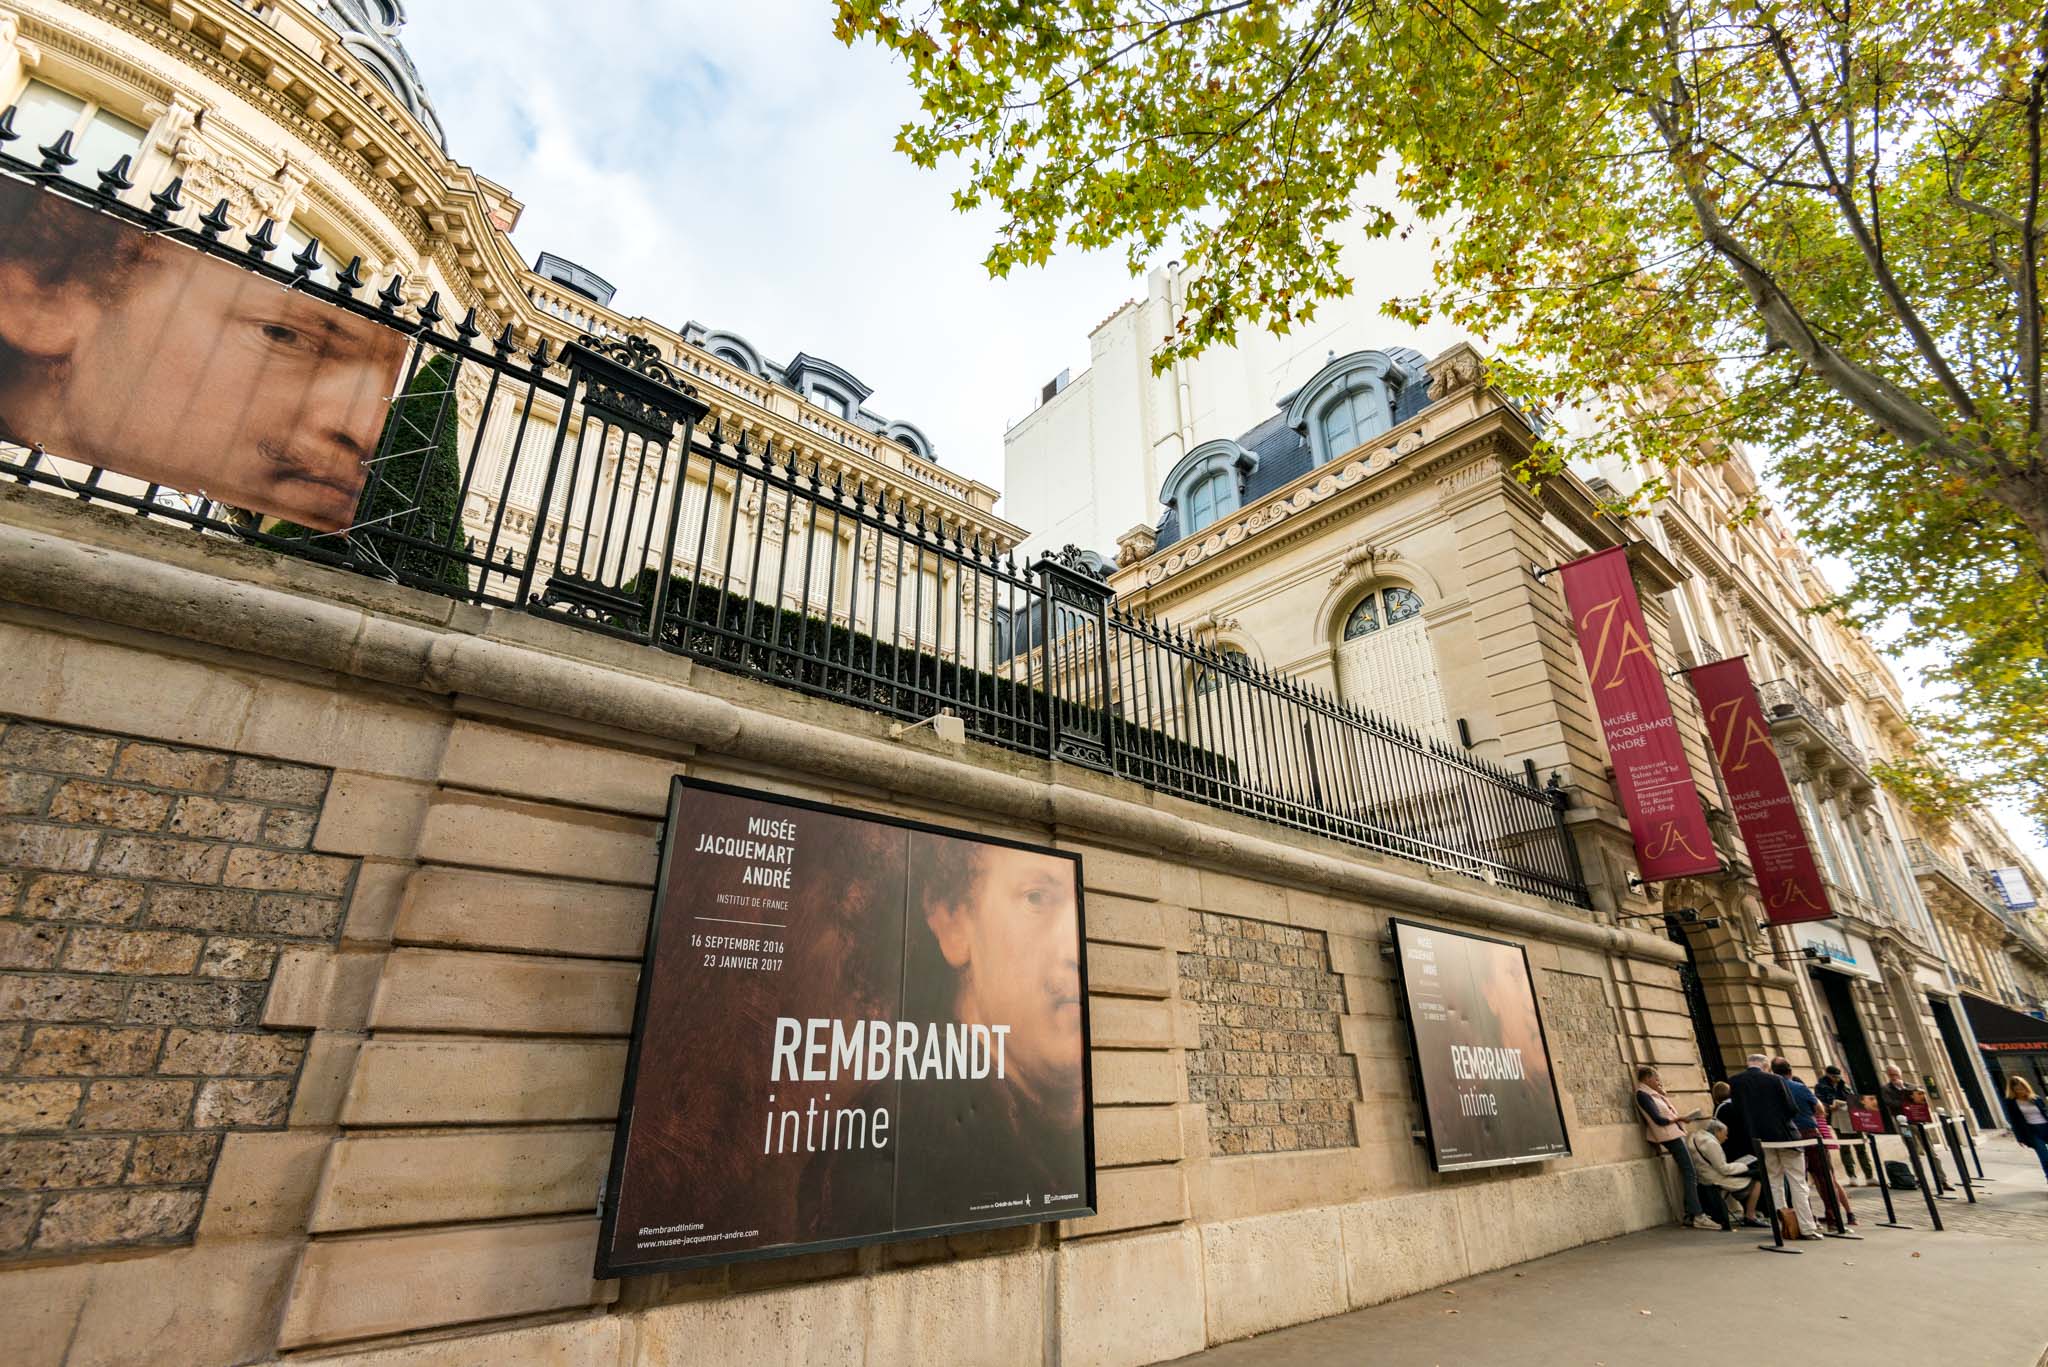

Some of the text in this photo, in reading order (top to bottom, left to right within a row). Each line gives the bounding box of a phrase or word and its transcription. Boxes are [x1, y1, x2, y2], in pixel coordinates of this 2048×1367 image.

[1603, 712, 1638, 727] MUSÉE
[1607, 716, 1673, 740] JACQUEMART
[1610, 735, 1647, 752] ANDRÉ
[748, 816, 797, 841] MUSÉE
[695, 833, 795, 865] JACQUEMART
[742, 866, 792, 889] ANDRÉ
[716, 894, 789, 911] INSTITUT DE FRANCE
[691, 934, 784, 954] 16 SEPTEMBRE 2016
[703, 954, 782, 971] 23 JANVIER 2017
[771, 1017, 1011, 1082] REMBRANDT
[1450, 1045, 1526, 1080] REMBRANDT
[1458, 1084, 1498, 1117] intime
[764, 1093, 889, 1155] intime
[637, 1229, 759, 1249] www.musee-jacquemart-andre.com
[638, 1223, 704, 1236] #RembrandtIntime
